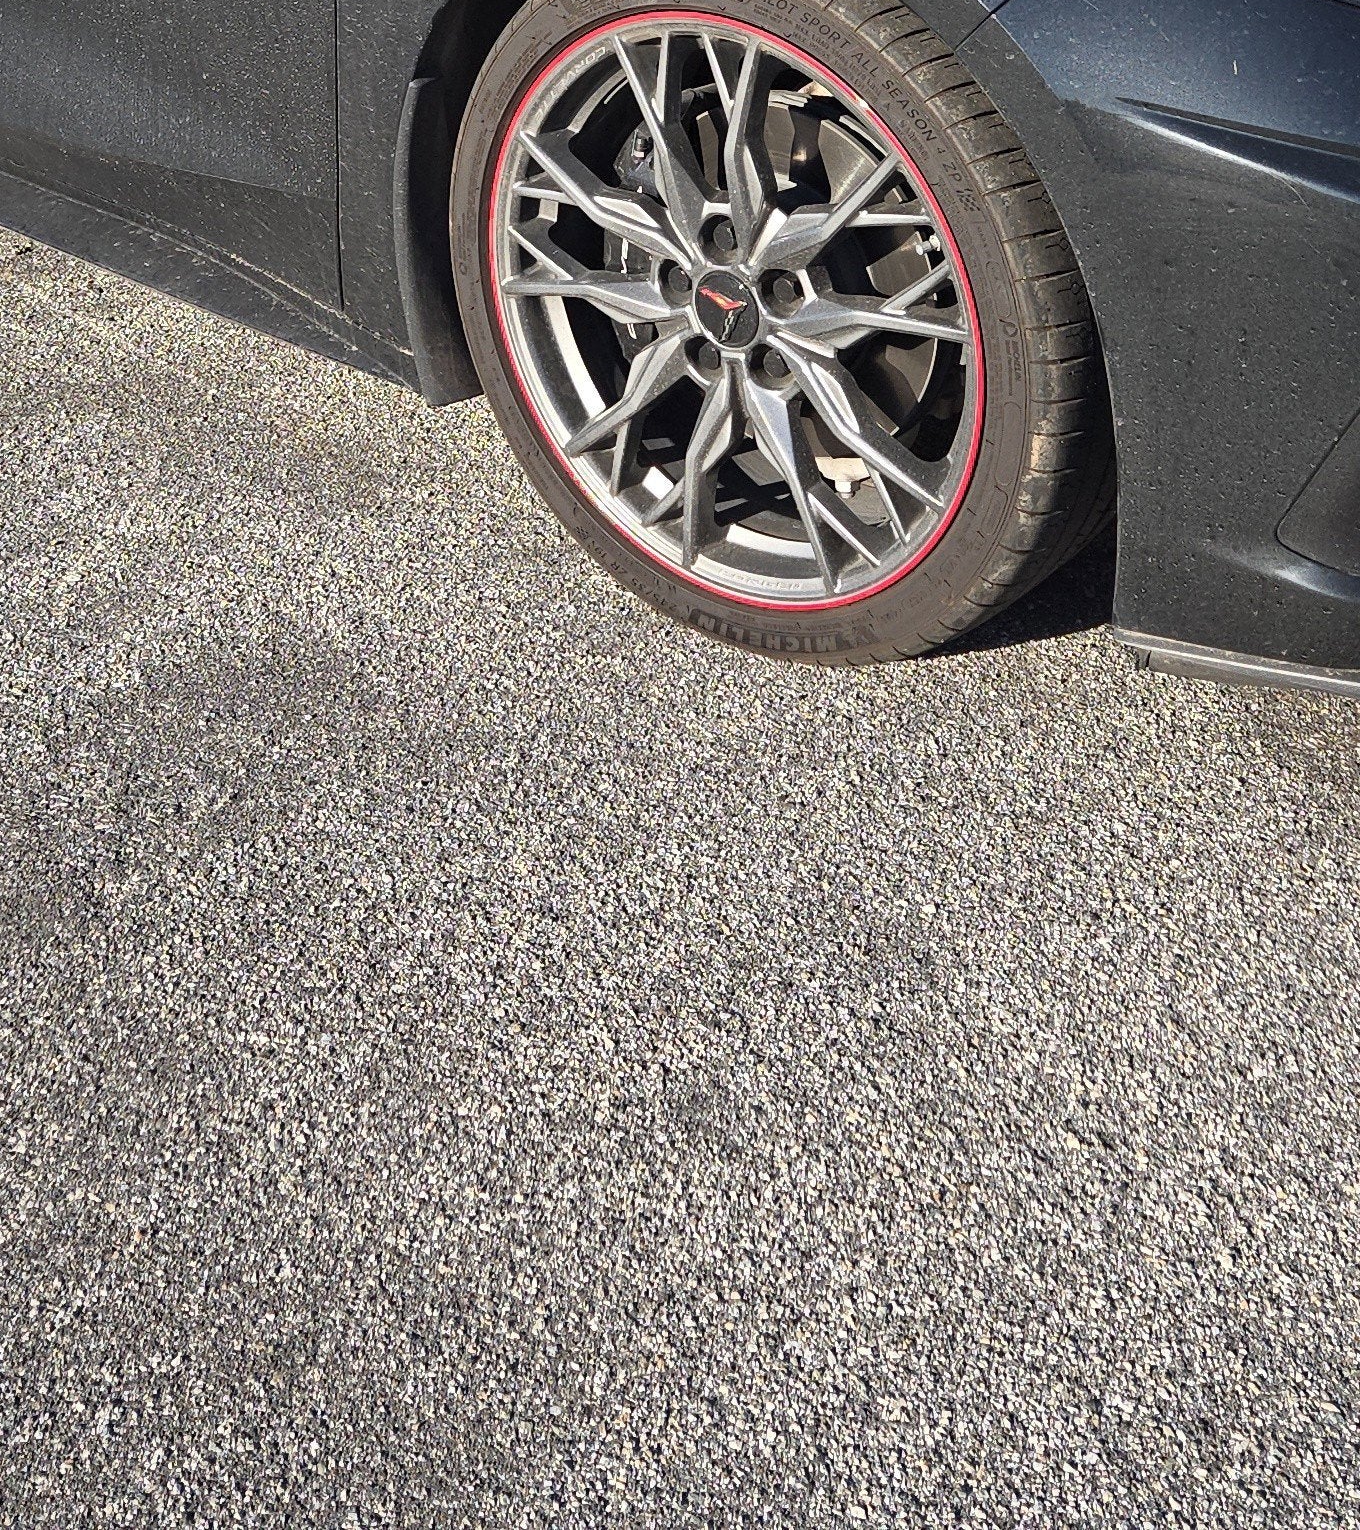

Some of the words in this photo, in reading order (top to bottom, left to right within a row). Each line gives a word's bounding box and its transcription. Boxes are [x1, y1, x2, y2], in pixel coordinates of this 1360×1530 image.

[800, 12, 851, 49] SPORT
[851, 51, 879, 78] ALL
[881, 79, 938, 143] SEASON
[696, 613, 839, 653] MICHELIN
